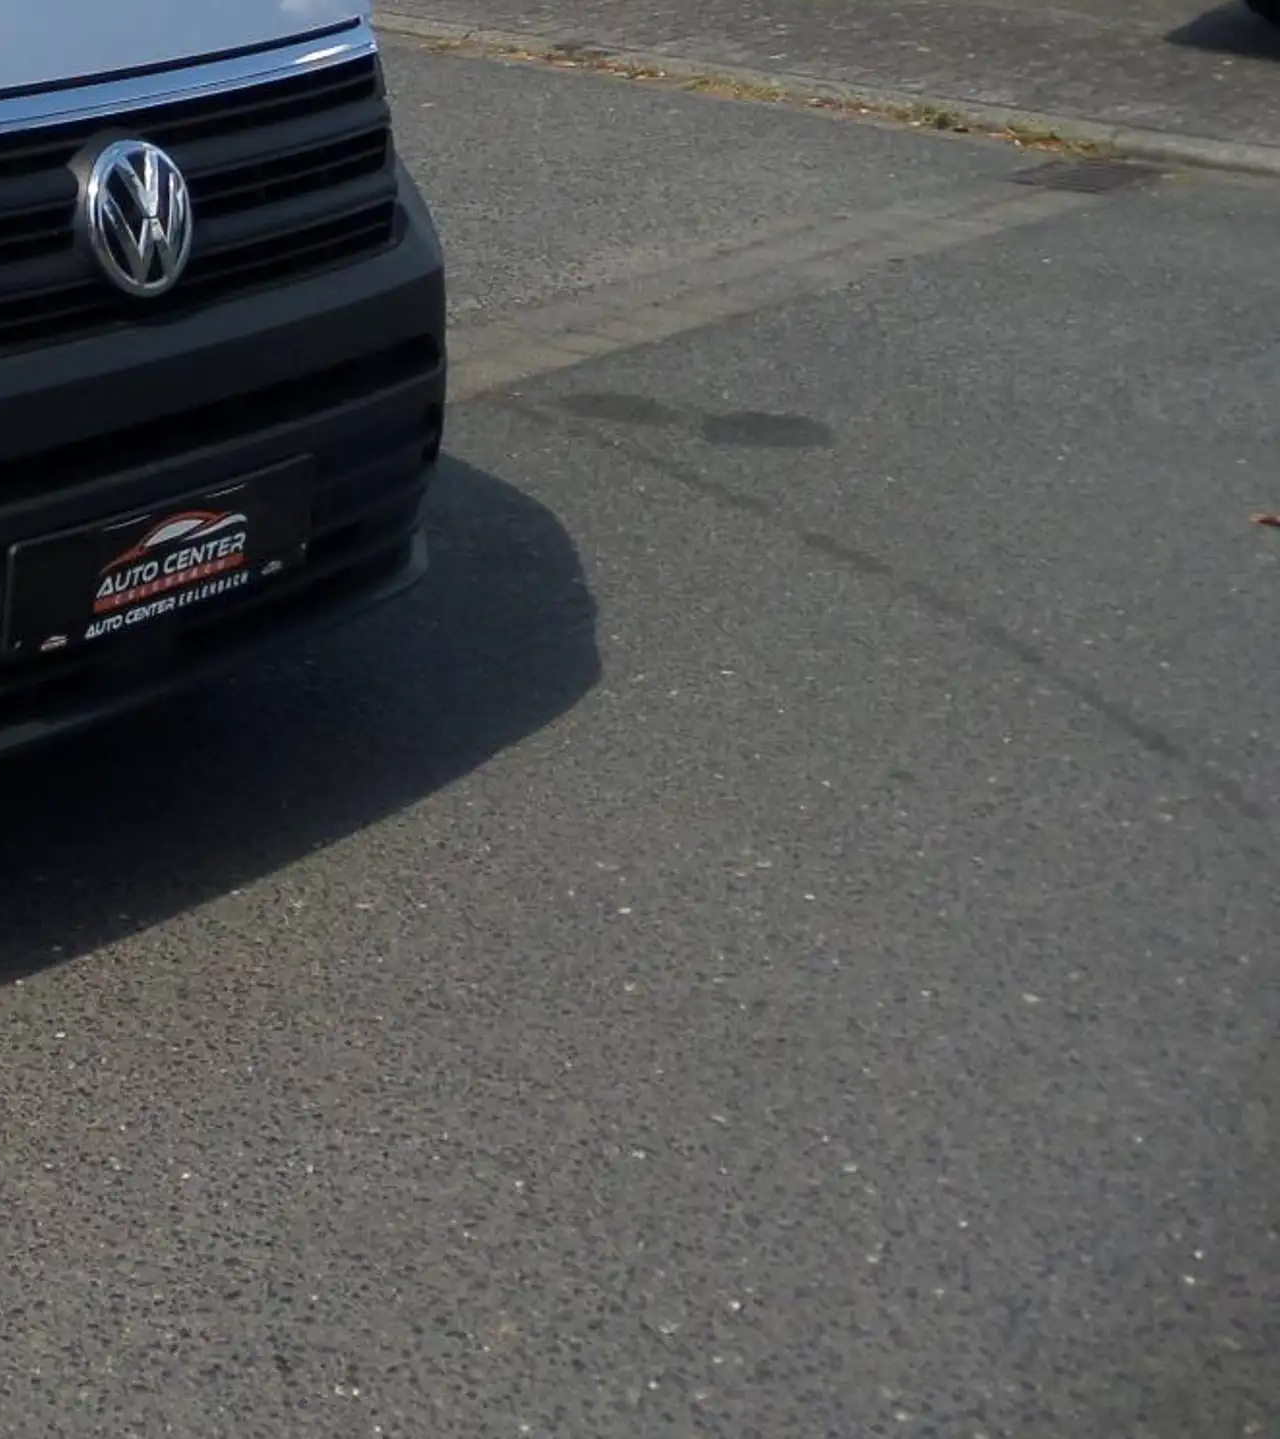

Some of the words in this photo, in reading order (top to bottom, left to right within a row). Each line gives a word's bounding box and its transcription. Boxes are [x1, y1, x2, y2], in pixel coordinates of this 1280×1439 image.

[96, 561, 159, 599] AUTO
[163, 531, 247, 575] CENTER
[84, 614, 124, 641] AUTO
[125, 596, 176, 624] CENTER
